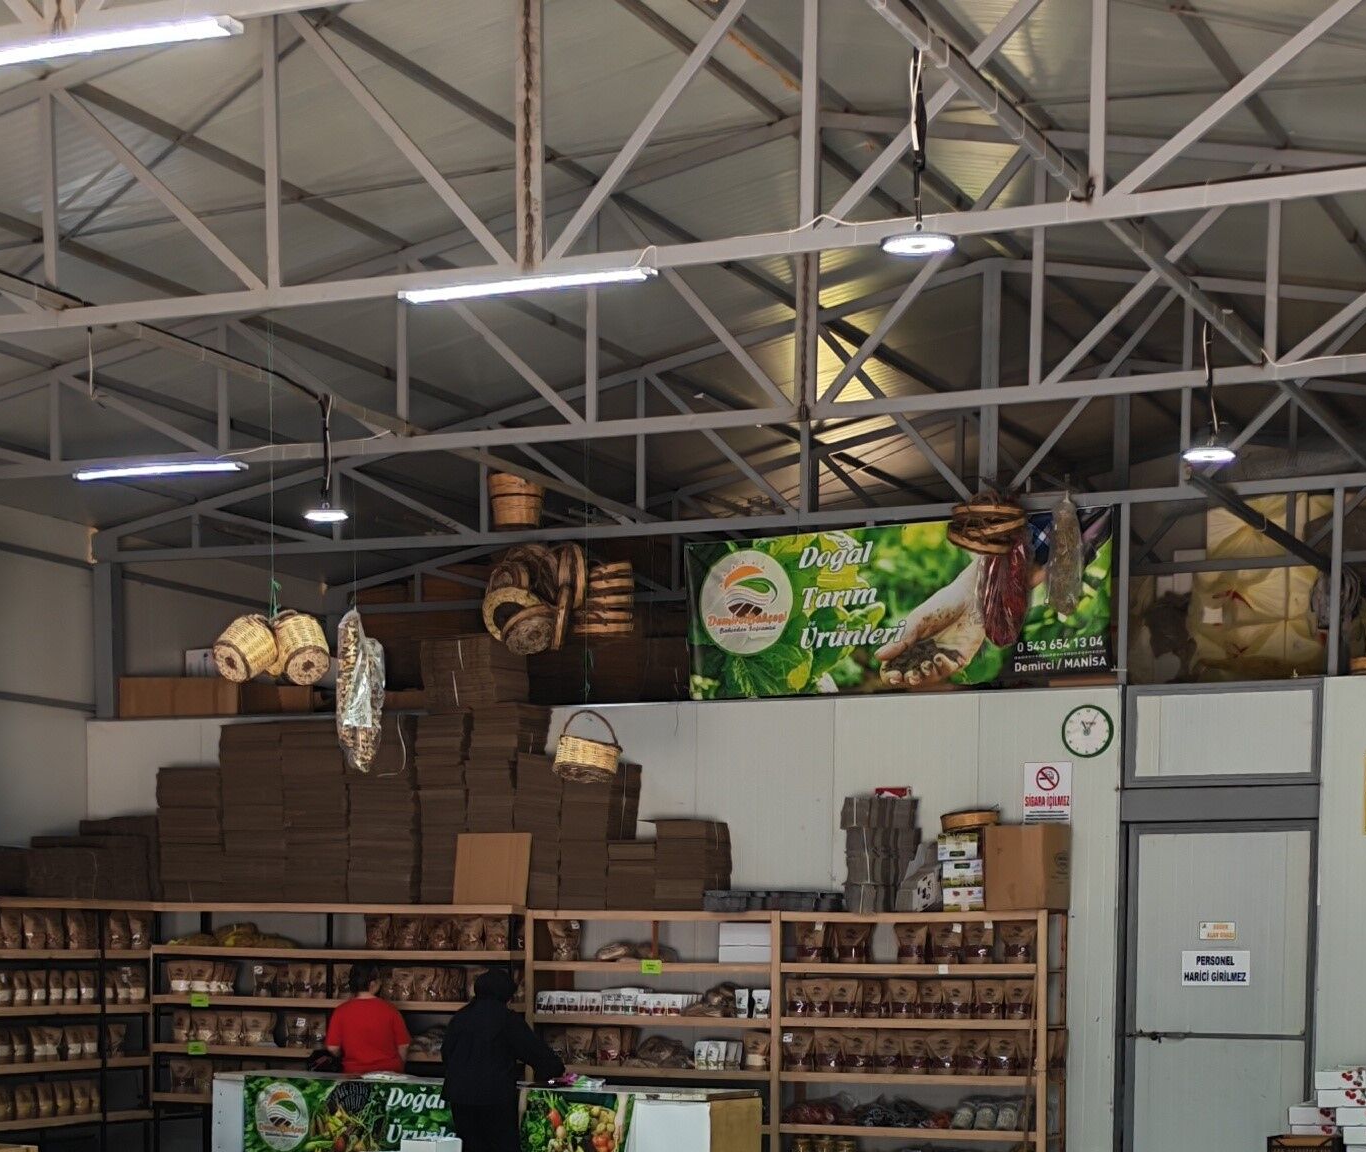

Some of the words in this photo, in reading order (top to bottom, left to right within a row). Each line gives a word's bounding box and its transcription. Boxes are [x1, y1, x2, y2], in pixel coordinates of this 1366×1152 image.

[798, 541, 873, 572] Doğal
[801, 587, 878, 610] Tarım
[800, 620, 907, 650] Ürünleri
[1017, 642, 1024, 652] 0
[1027, 640, 1047, 652] 543
[1049, 638, 1070, 650] 654
[1073, 637, 1087, 648] 13
[1089, 635, 1104, 647] 04
[1014, 660, 1055, 672] Demirci
[1064, 655, 1107, 669] MANİSA
[1025, 793, 1045, 807] SİGARA
[1196, 955, 1235, 966] PERSONEL
[1184, 970, 1209, 981] HARİCİ
[1211, 970, 1247, 982] GİRİLMEZ
